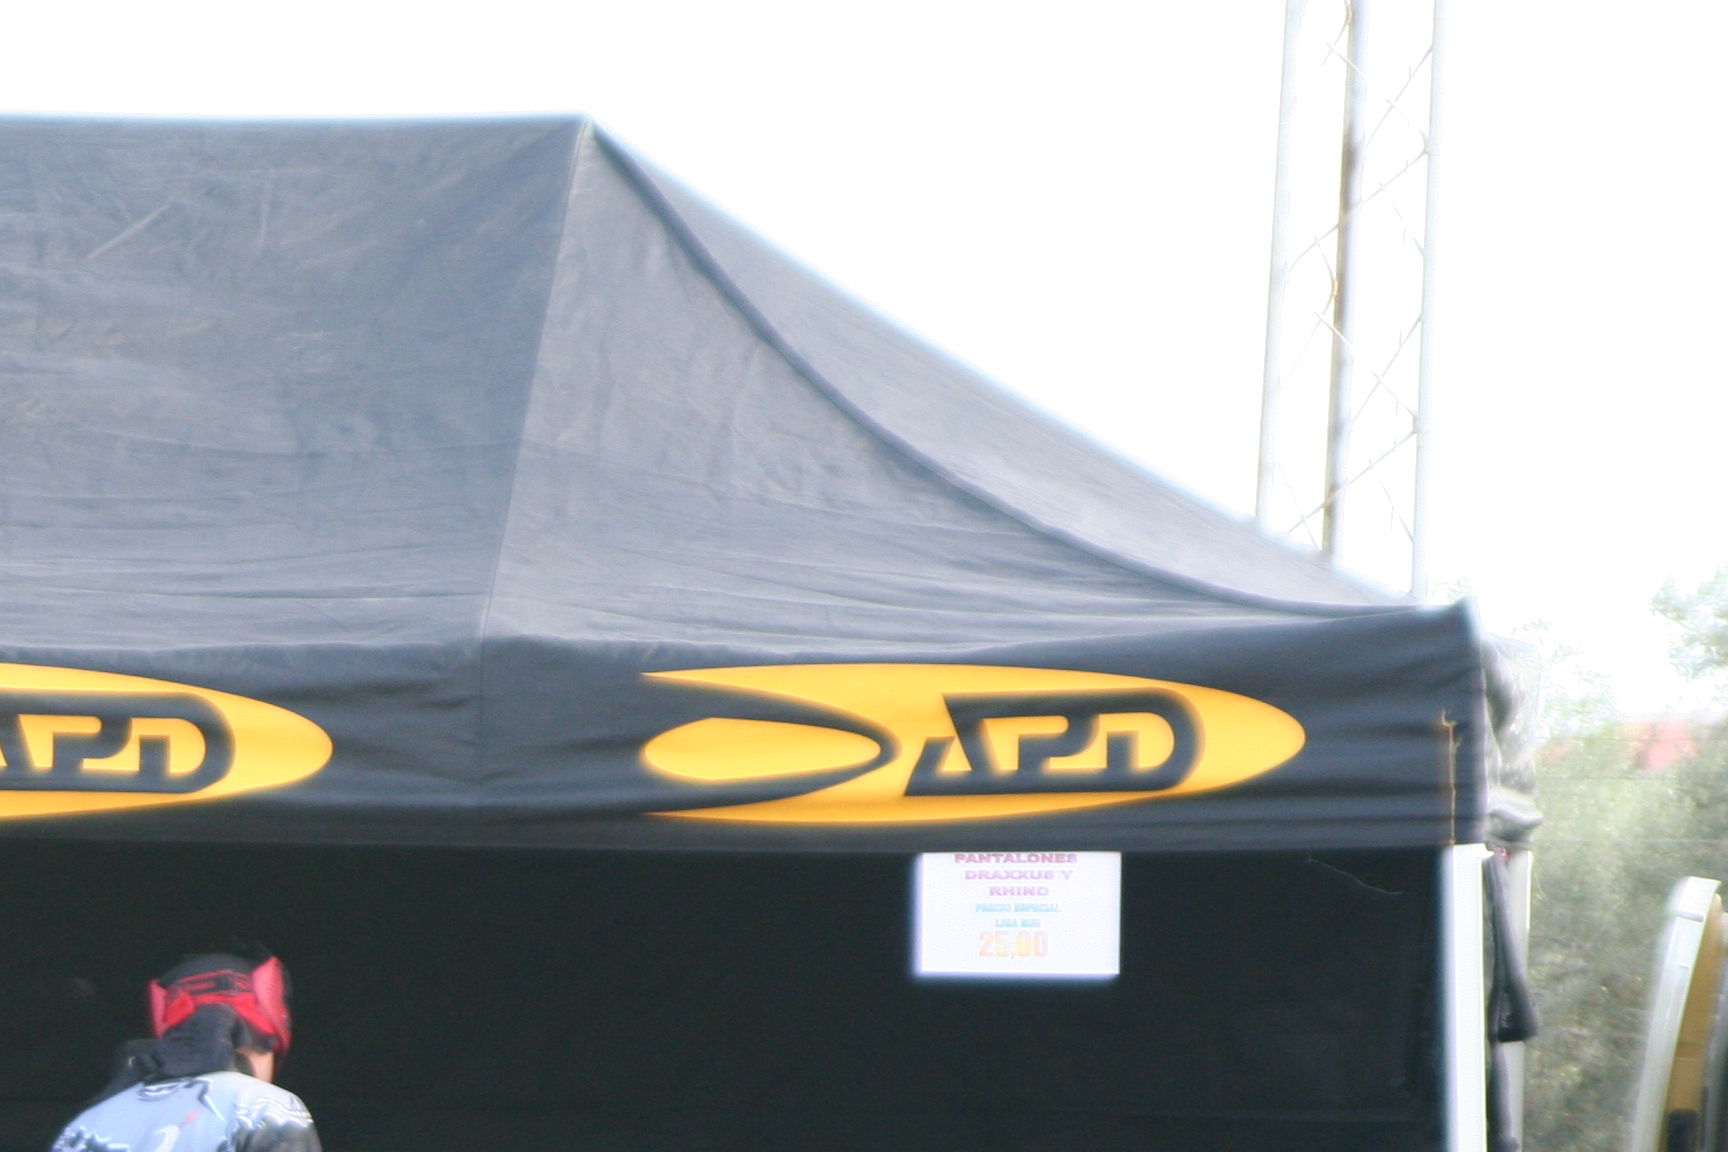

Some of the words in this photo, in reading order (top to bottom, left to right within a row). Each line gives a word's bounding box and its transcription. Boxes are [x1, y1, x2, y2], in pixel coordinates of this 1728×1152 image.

[954, 853, 1078, 864] PANTALONES
[964, 869, 1055, 880] DRAXXUS
[1060, 869, 1075, 880] Y
[989, 886, 1050, 896] RHINO
